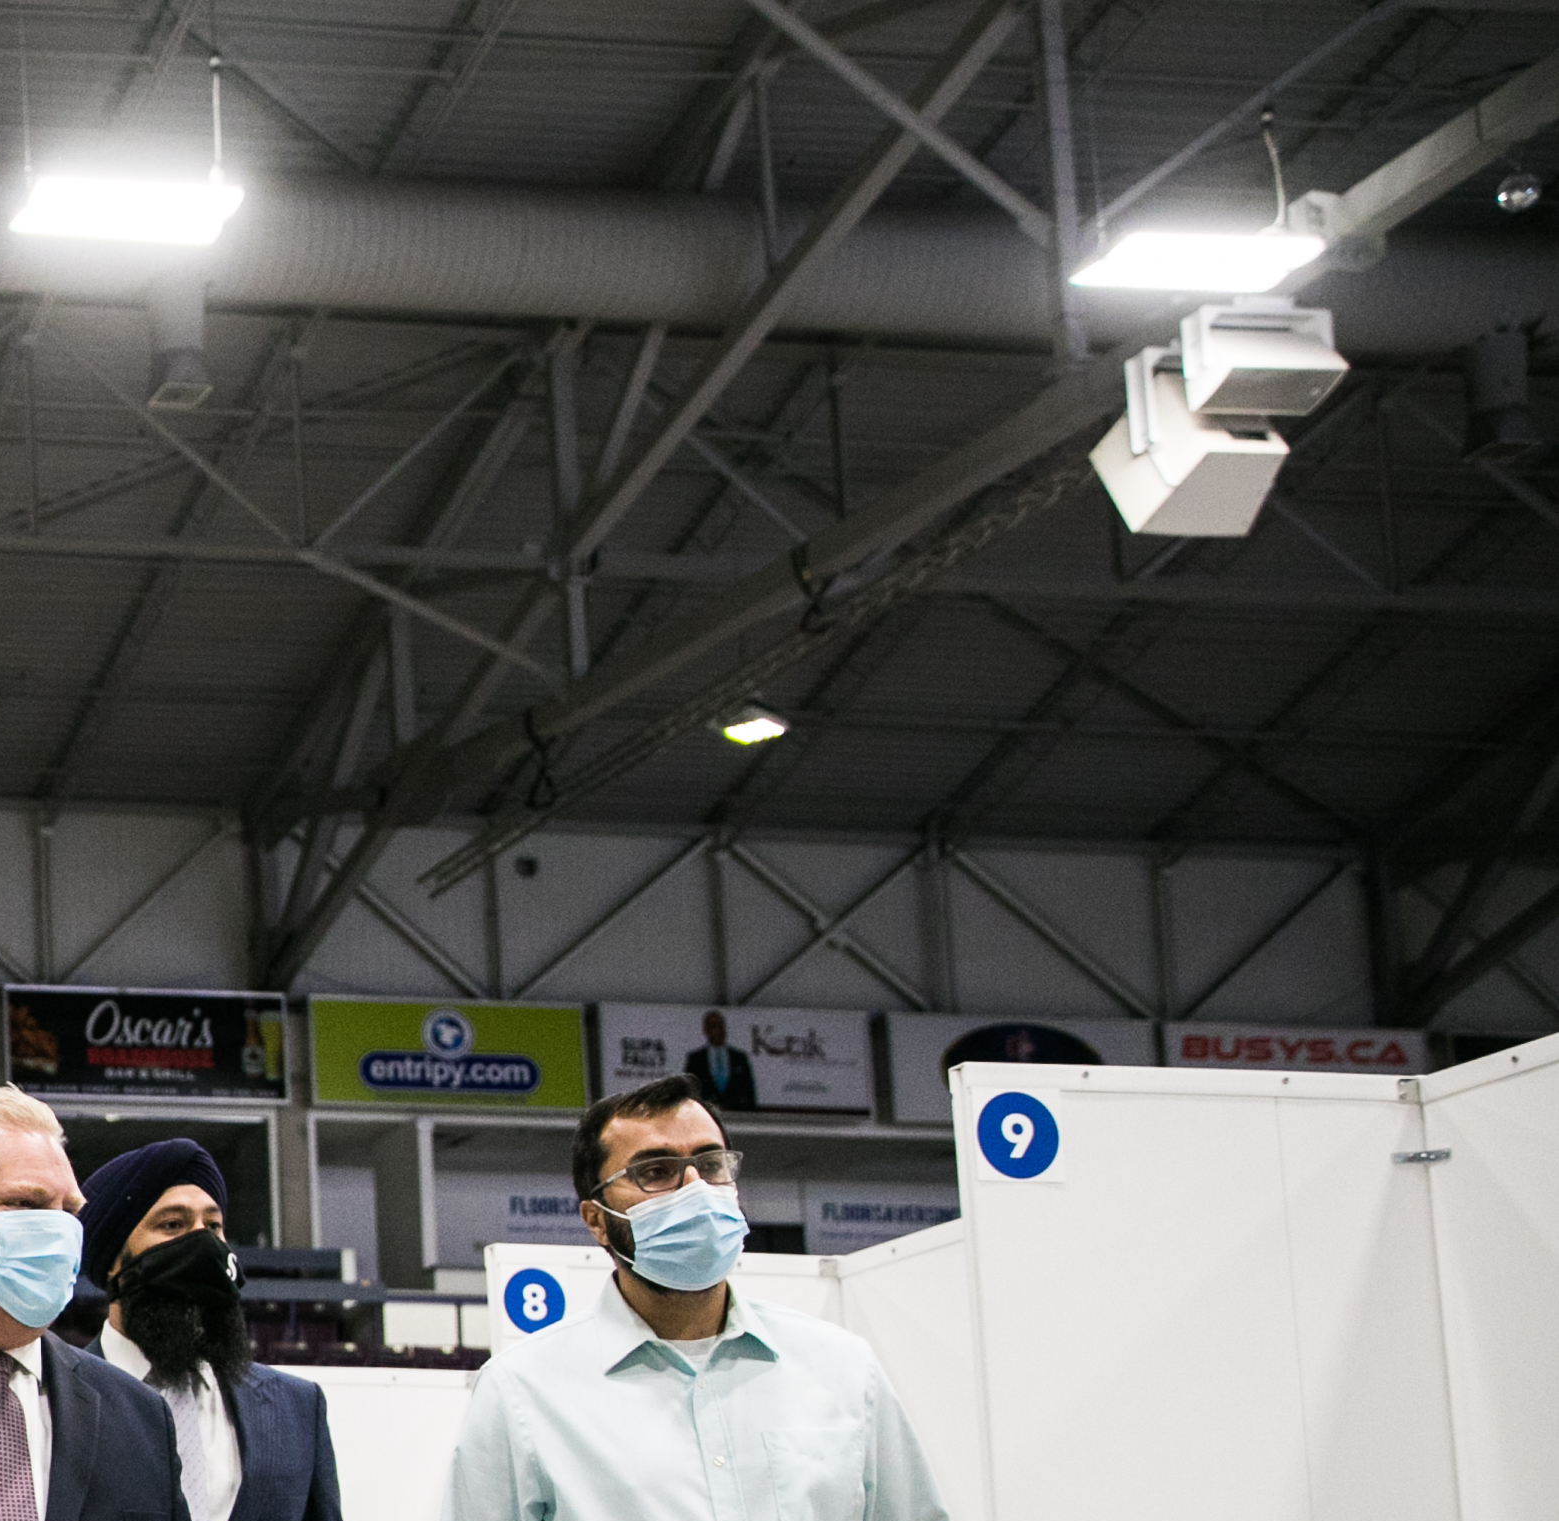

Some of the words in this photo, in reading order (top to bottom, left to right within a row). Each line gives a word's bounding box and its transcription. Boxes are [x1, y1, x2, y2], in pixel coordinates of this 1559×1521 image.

[86, 1000, 214, 1048] Oscar's
[1182, 1035, 1409, 1066] BUSYS.CA
[370, 1057, 531, 1087] entripy.com
[1001, 1113, 1034, 1159] 9
[522, 1282, 549, 1322] 8
